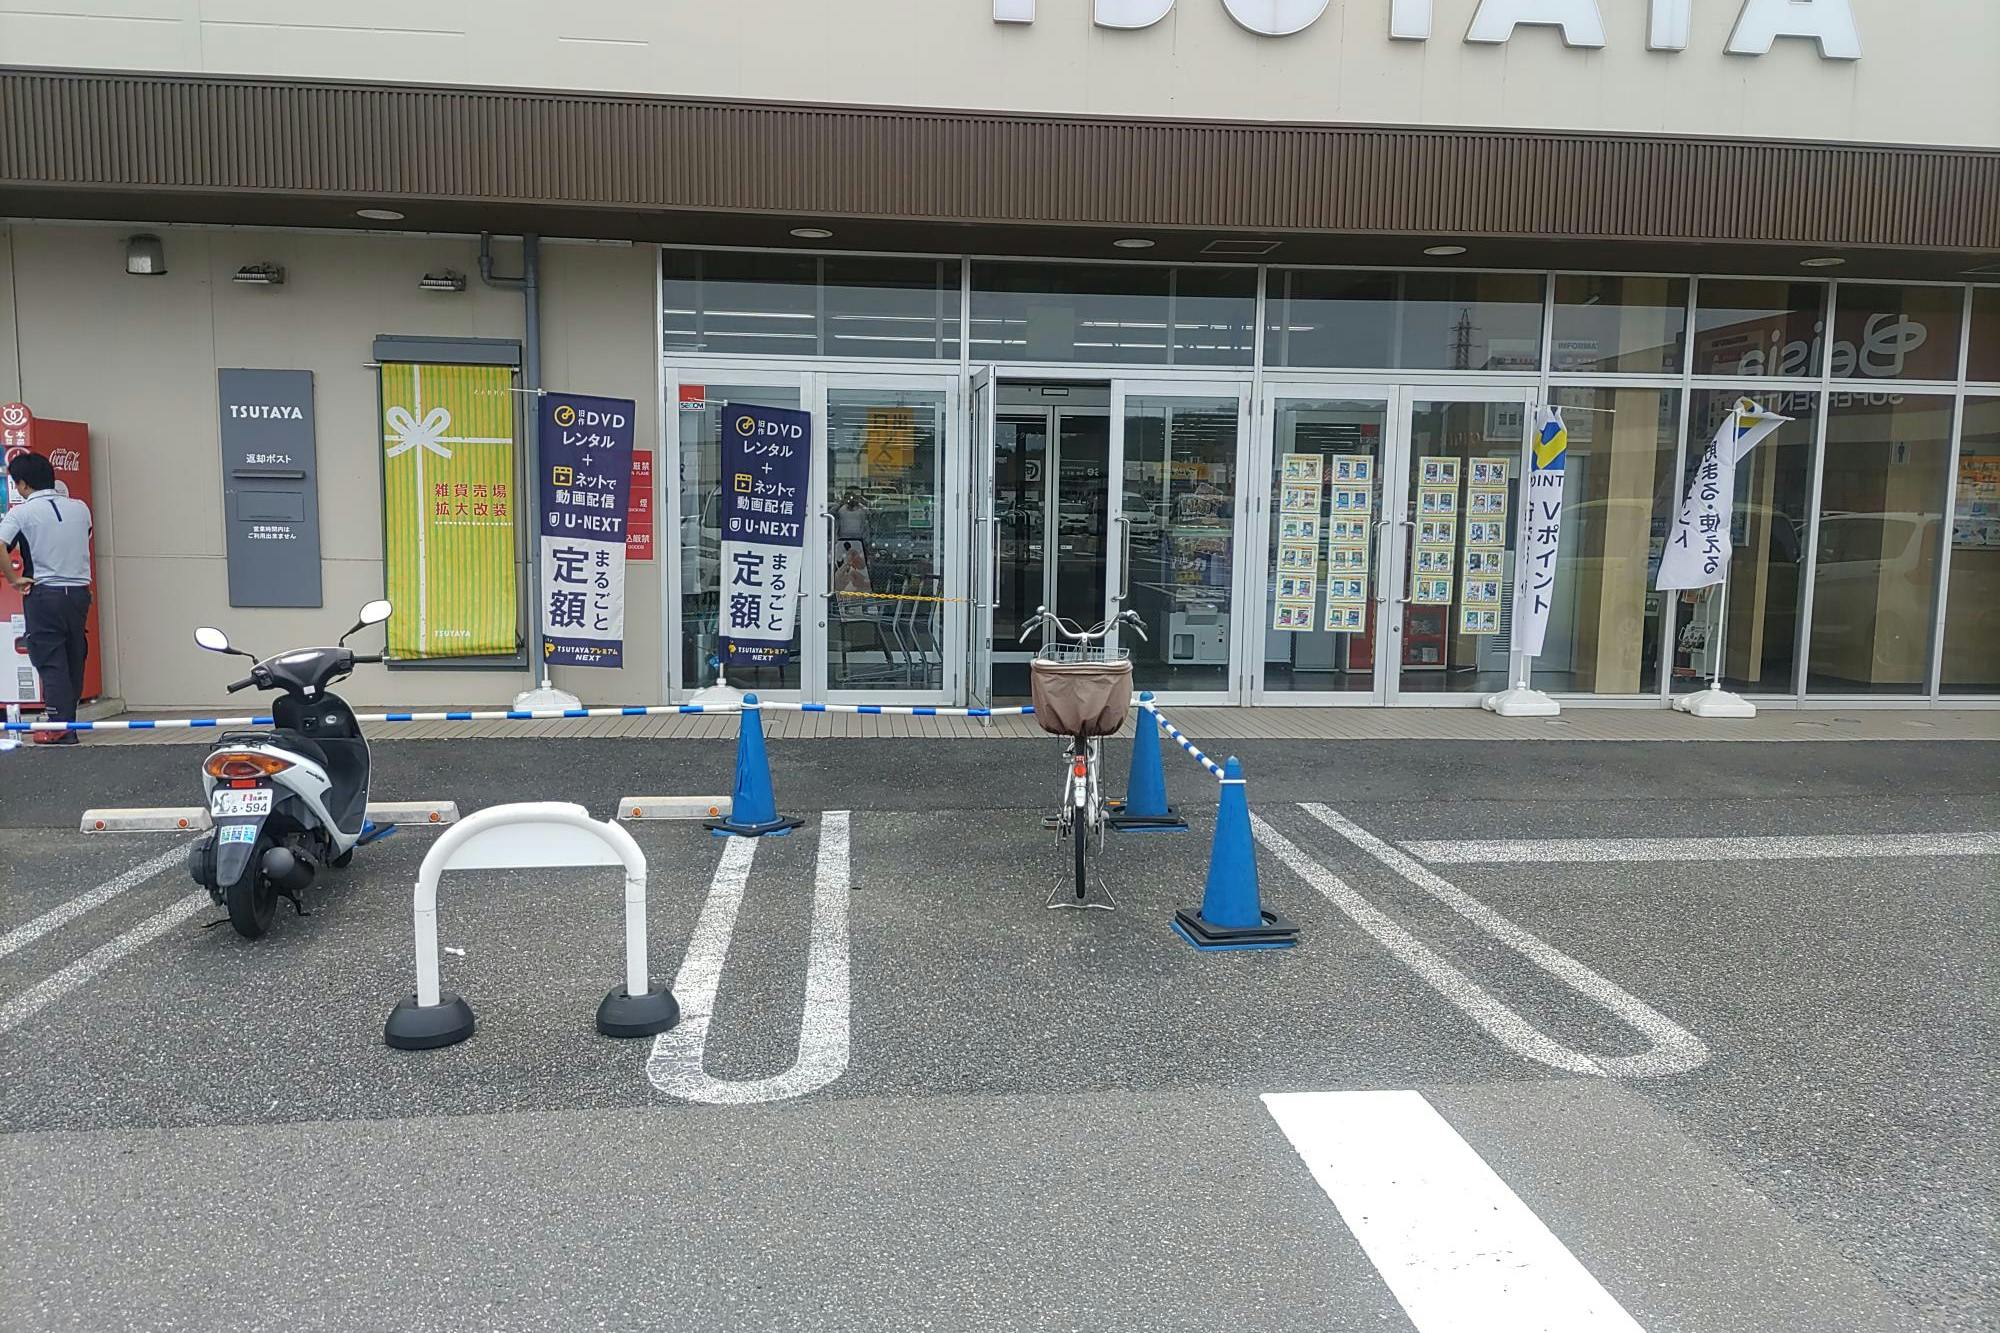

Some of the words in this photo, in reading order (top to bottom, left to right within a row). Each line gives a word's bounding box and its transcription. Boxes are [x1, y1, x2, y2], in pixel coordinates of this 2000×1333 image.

[230, 405, 303, 419] TSUTAYA
[587, 411, 625, 428] DVD
[767, 422, 802, 438] DVD
[563, 431, 615, 448] レンタル
[743, 441, 793, 457] レンタル
[246, 453, 292, 464] 返却ポスト
[575, 473, 617, 490] ネットで
[754, 480, 795, 498] ネットで
[435, 483, 507, 498] 雑貨売場
[556, 489, 615, 509] 動画配信
[435, 502, 507, 517] 拡大改装
[737, 495, 794, 515] 動画配信
[564, 513, 622, 533] U-NEXT
[745, 518, 799, 538] U-NEXT
[1533, 501, 1561, 614] Vポイント
[549, 546, 589, 628] 定額
[594, 549, 611, 631] まるごと
[729, 550, 764, 630] 定額
[767, 553, 788, 632] まるごと
[434, 629, 471, 638] TSUTAYA
[575, 654, 601, 662] NEXT
